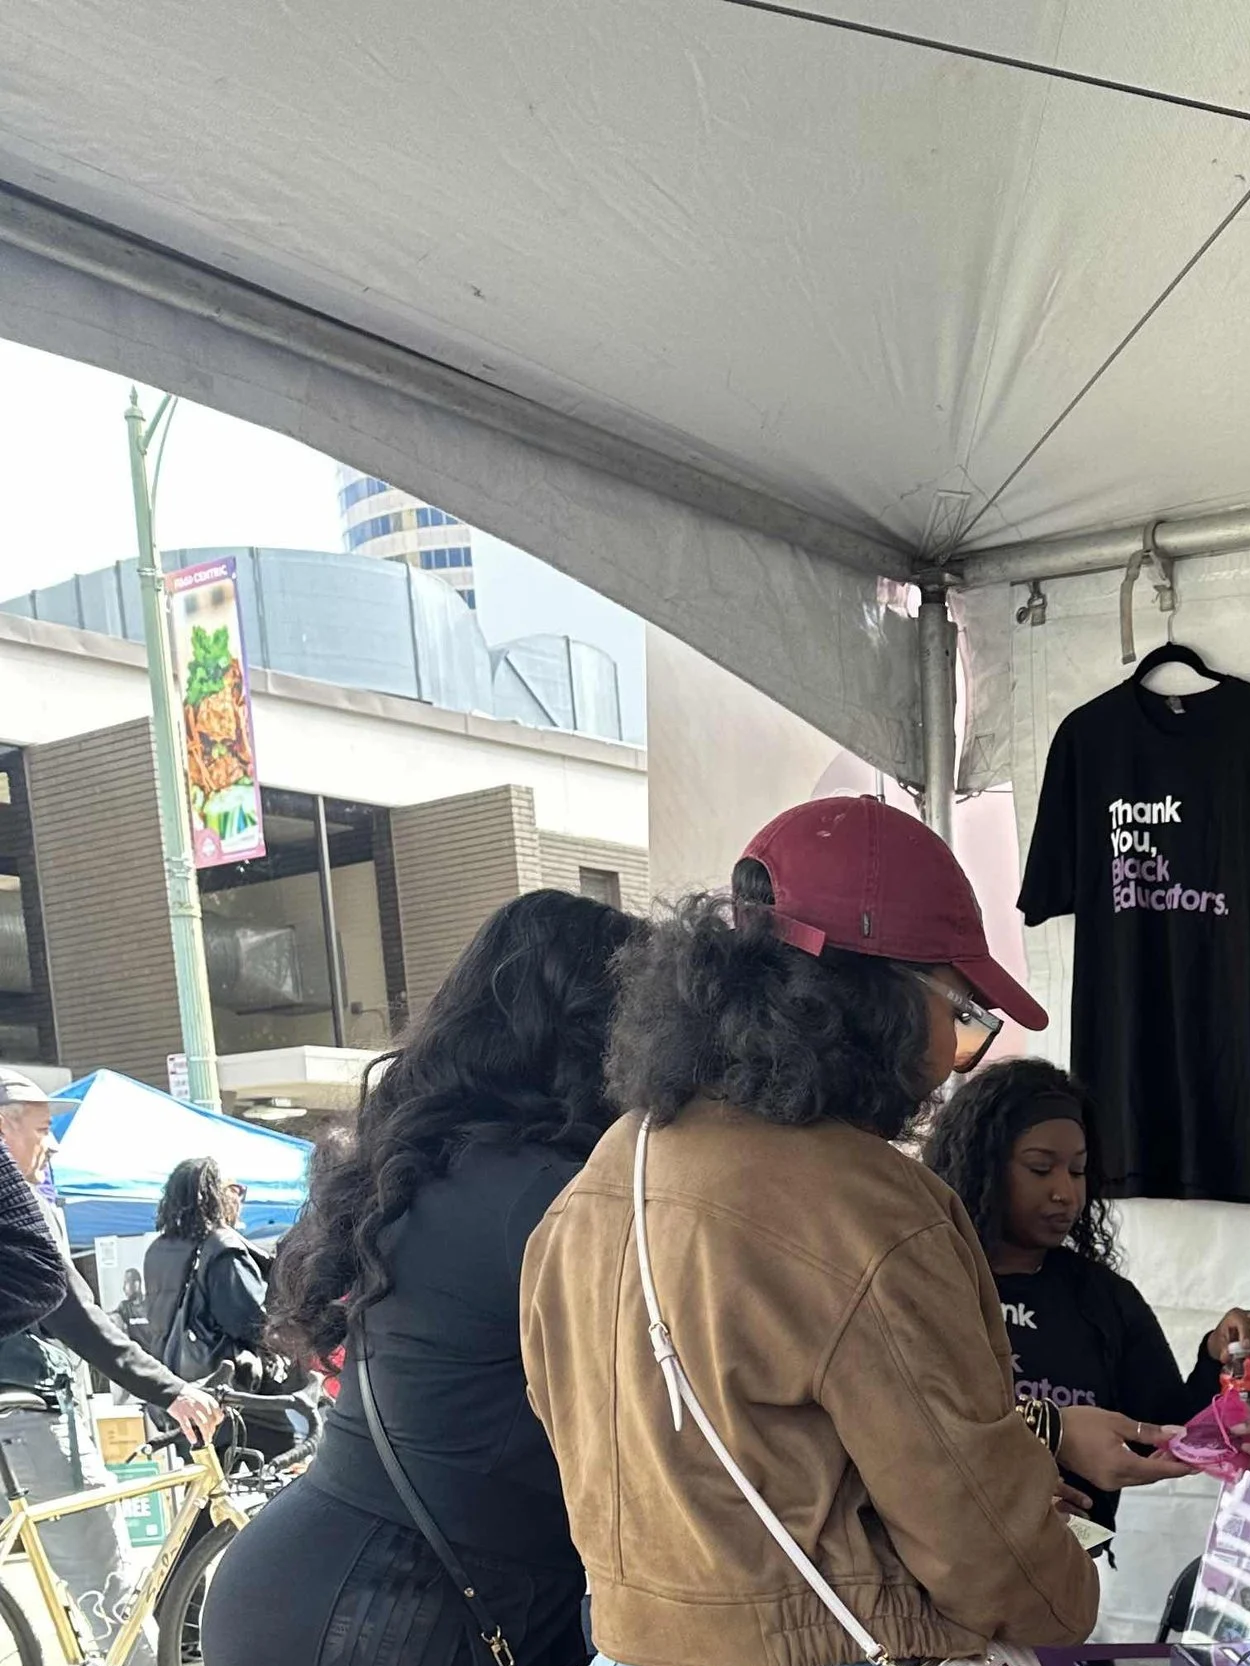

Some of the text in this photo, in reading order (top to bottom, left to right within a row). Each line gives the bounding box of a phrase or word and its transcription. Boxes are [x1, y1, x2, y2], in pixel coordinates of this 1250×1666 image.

[1109, 795, 1182, 830] Thank
[1110, 828, 1157, 857] You,
[1112, 855, 1170, 886] Black
[1113, 881, 1229, 915] Educators.
[1015, 1377, 1096, 1406] ators
